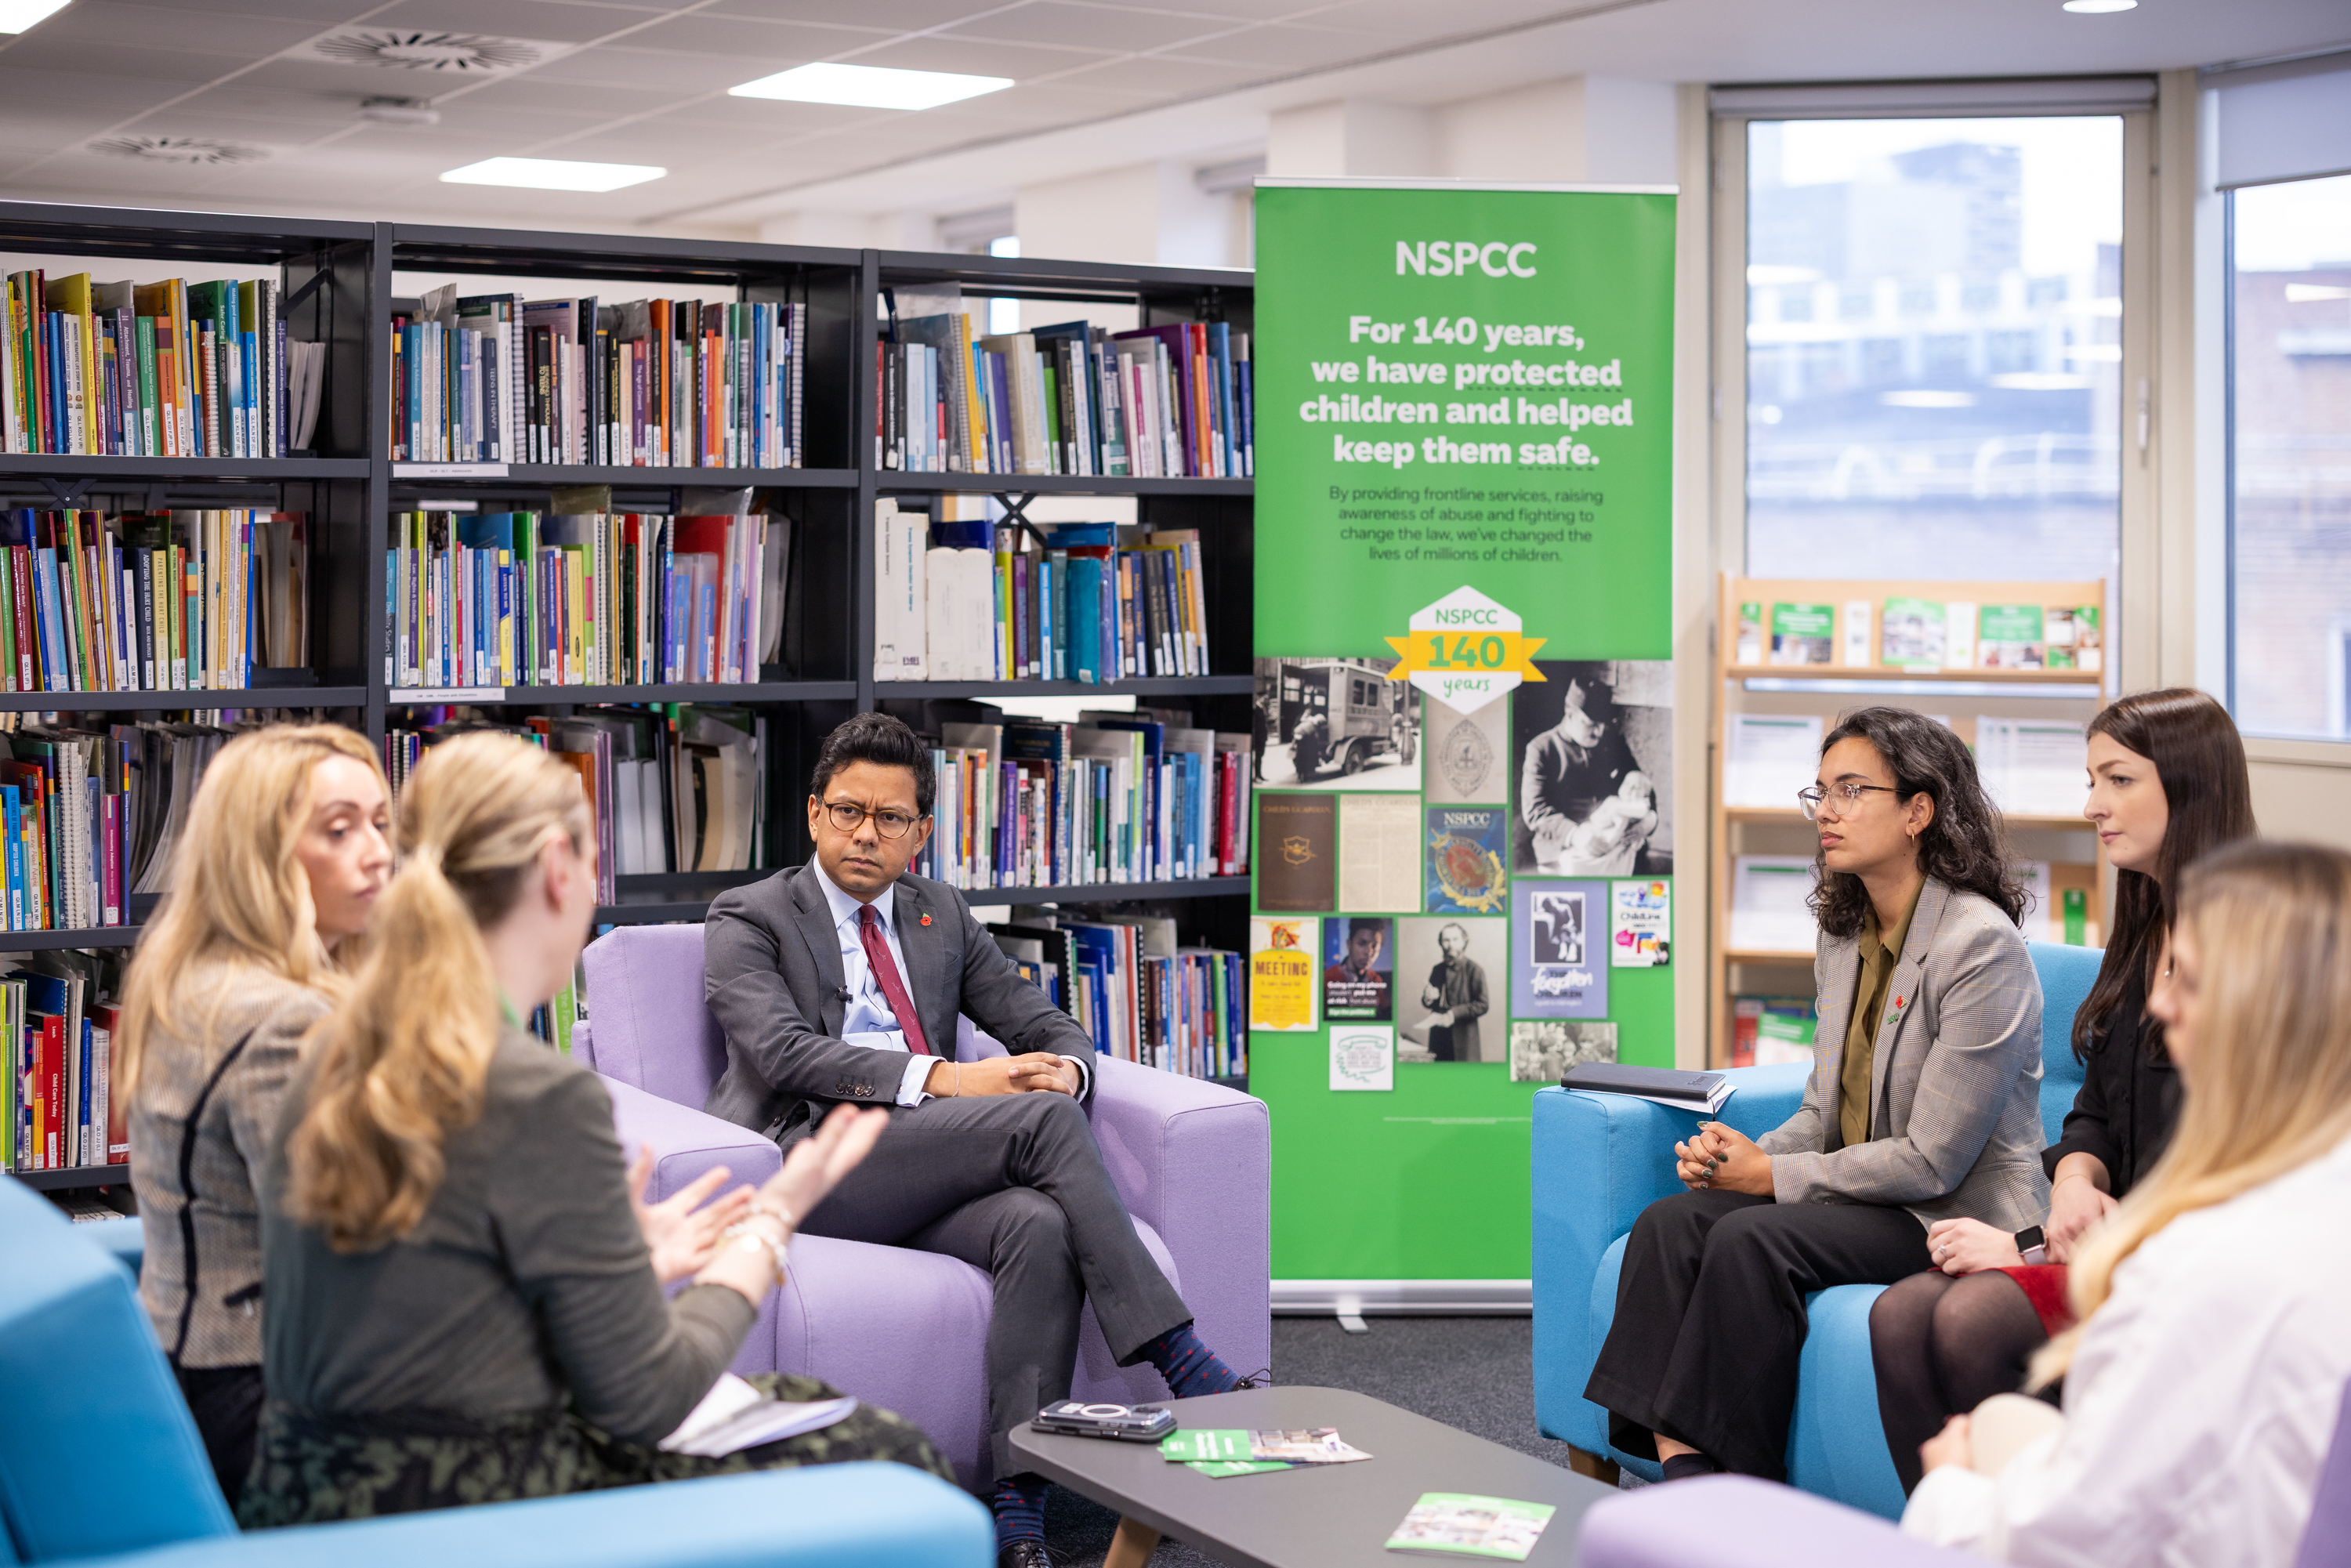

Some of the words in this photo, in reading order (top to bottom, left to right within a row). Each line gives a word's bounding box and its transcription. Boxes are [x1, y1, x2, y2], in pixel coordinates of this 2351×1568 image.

[1396, 241, 1537, 277] NSPCC
[1349, 316, 1404, 343] For
[1413, 317, 1477, 345] 140
[1483, 323, 1585, 352] years,
[1312, 362, 1358, 382] we
[1367, 357, 1446, 383] have
[1455, 359, 1621, 390] protected
[1300, 395, 1437, 423] children
[1446, 398, 1509, 425] and
[1517, 399, 1632, 430] helped
[1334, 435, 1415, 469] keep
[1422, 437, 1511, 464] them
[1519, 438, 1599, 465] safe.
[1330, 487, 1349, 503] By
[1353, 487, 1419, 504] providing
[1424, 487, 1484, 502] frontline
[1488, 490, 1551, 504] services,
[1556, 491, 1603, 505] raising
[1339, 509, 1416, 520] awareness
[1420, 507, 1435, 520] of
[1439, 508, 1483, 521] abuse
[1487, 508, 1514, 521] and
[1519, 508, 1575, 524] fighting
[1580, 509, 1594, 523] to
[1341, 527, 1394, 542] change
[1398, 528, 1422, 541] the
[1426, 528, 1452, 542] law,
[1457, 528, 1496, 542] we've
[1501, 528, 1564, 545] changed
[1568, 530, 1592, 542] the
[1369, 547, 1400, 559] lives
[1405, 547, 1419, 560] of
[1424, 547, 1480, 561] millions
[1483, 548, 1498, 561] of
[1501, 548, 1561, 562] children.
[1436, 610, 1498, 625] NSPCC
[1428, 635, 1505, 668] 140
[1443, 678, 1490, 697] years
[1444, 812, 1490, 825] NSPCC
[1255, 961, 1307, 976] MEETING
[1530, 966, 1593, 995] forgotten
